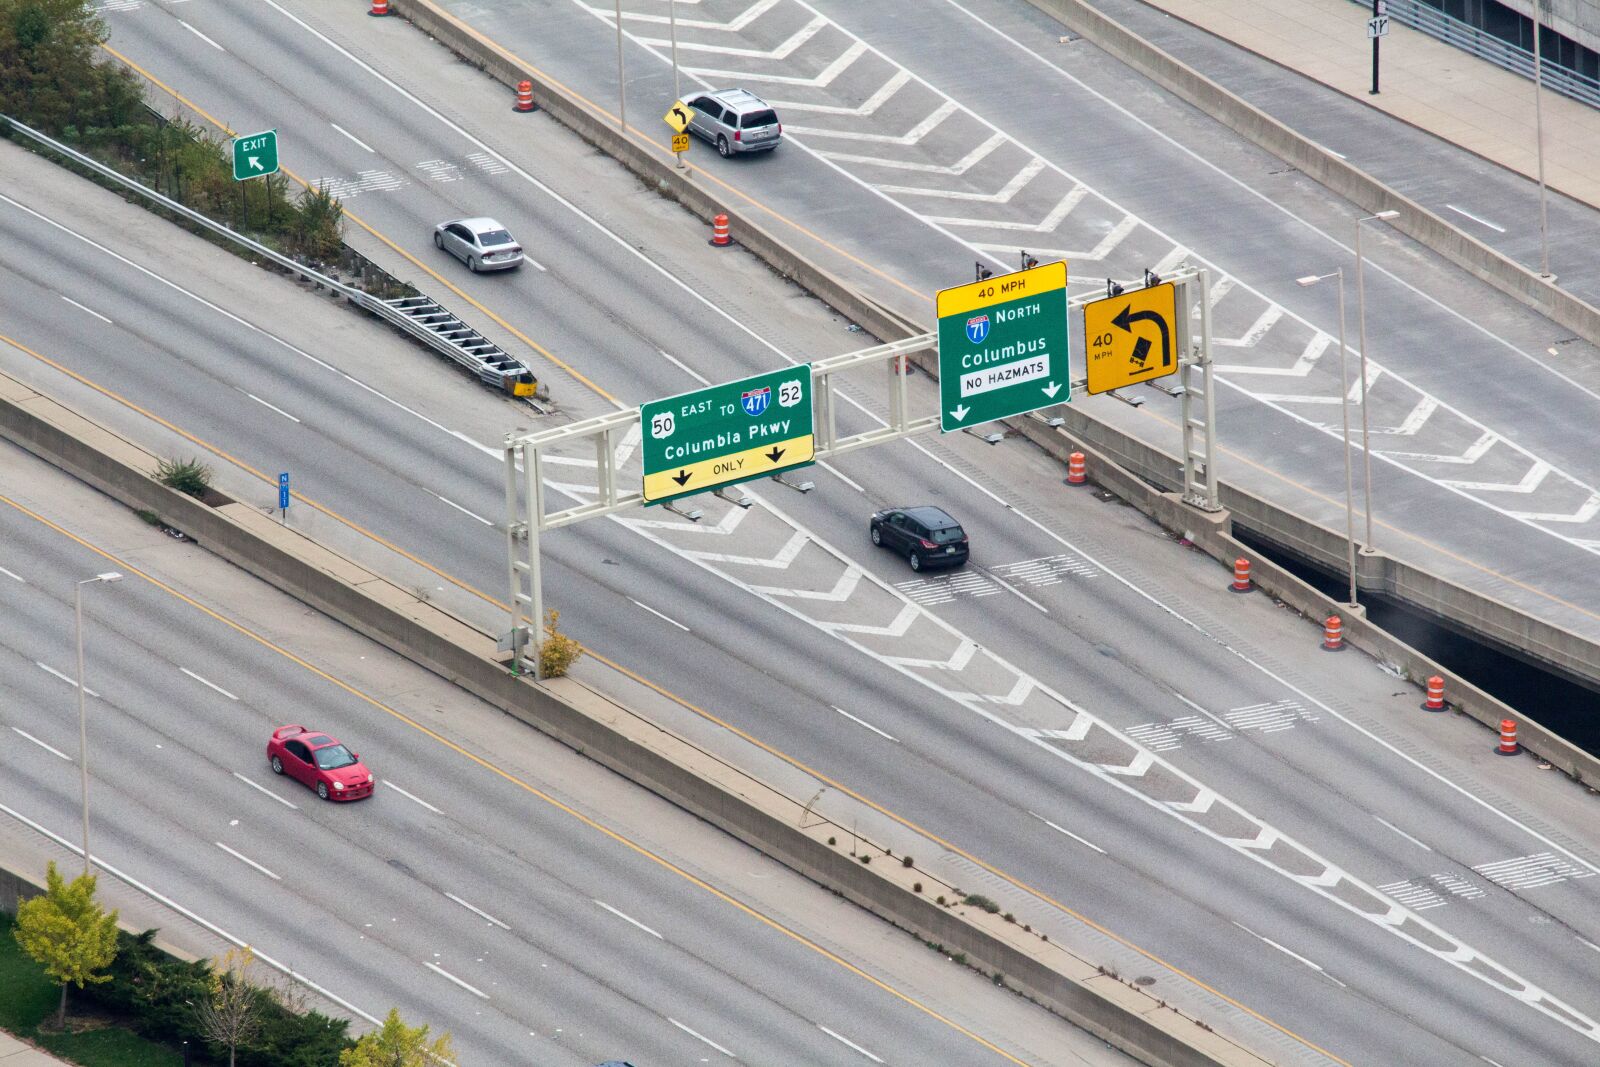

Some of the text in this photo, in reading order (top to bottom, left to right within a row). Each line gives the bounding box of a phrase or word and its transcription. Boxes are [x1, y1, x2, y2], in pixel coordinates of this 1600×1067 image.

[242, 136, 267, 152] EXIT
[674, 136, 688, 145] 40
[978, 279, 1026, 299] 40 MPH
[970, 322, 984, 339] 71
[996, 303, 1040, 324] NORTH
[1092, 332, 1113, 348] 40
[961, 337, 1046, 369] Columbus
[1094, 350, 1113, 361] MPH
[966, 362, 1044, 390] NO HAZMATS
[653, 417, 673, 435] 50
[681, 399, 713, 417] EAST
[719, 403, 735, 416] TO
[746, 393, 767, 412] 471
[781, 385, 800, 403] 52
[664, 419, 791, 460] Columbia Pkwy
[713, 458, 745, 475] ONLY
[281, 474, 288, 482] N
